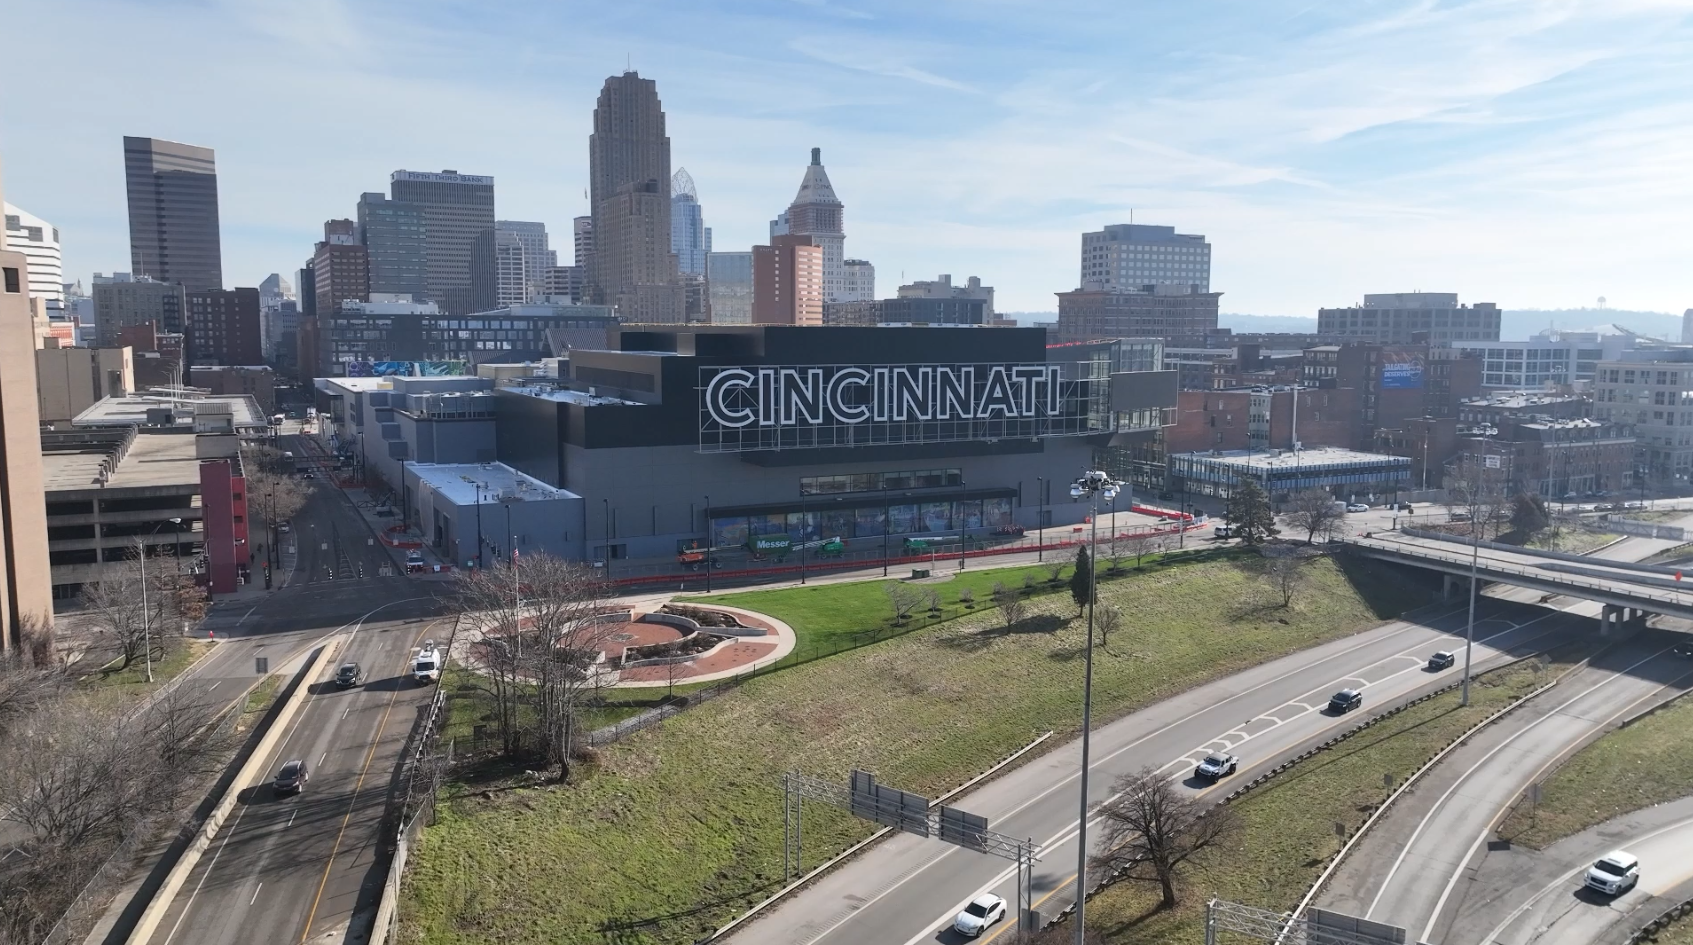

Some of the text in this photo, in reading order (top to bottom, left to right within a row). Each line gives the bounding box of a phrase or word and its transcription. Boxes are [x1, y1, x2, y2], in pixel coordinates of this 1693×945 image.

[408, 172, 430, 180] FIFTH
[435, 174, 458, 182] THIRD
[706, 366, 1061, 428] CINCINNATI
[756, 540, 790, 549] Messer
